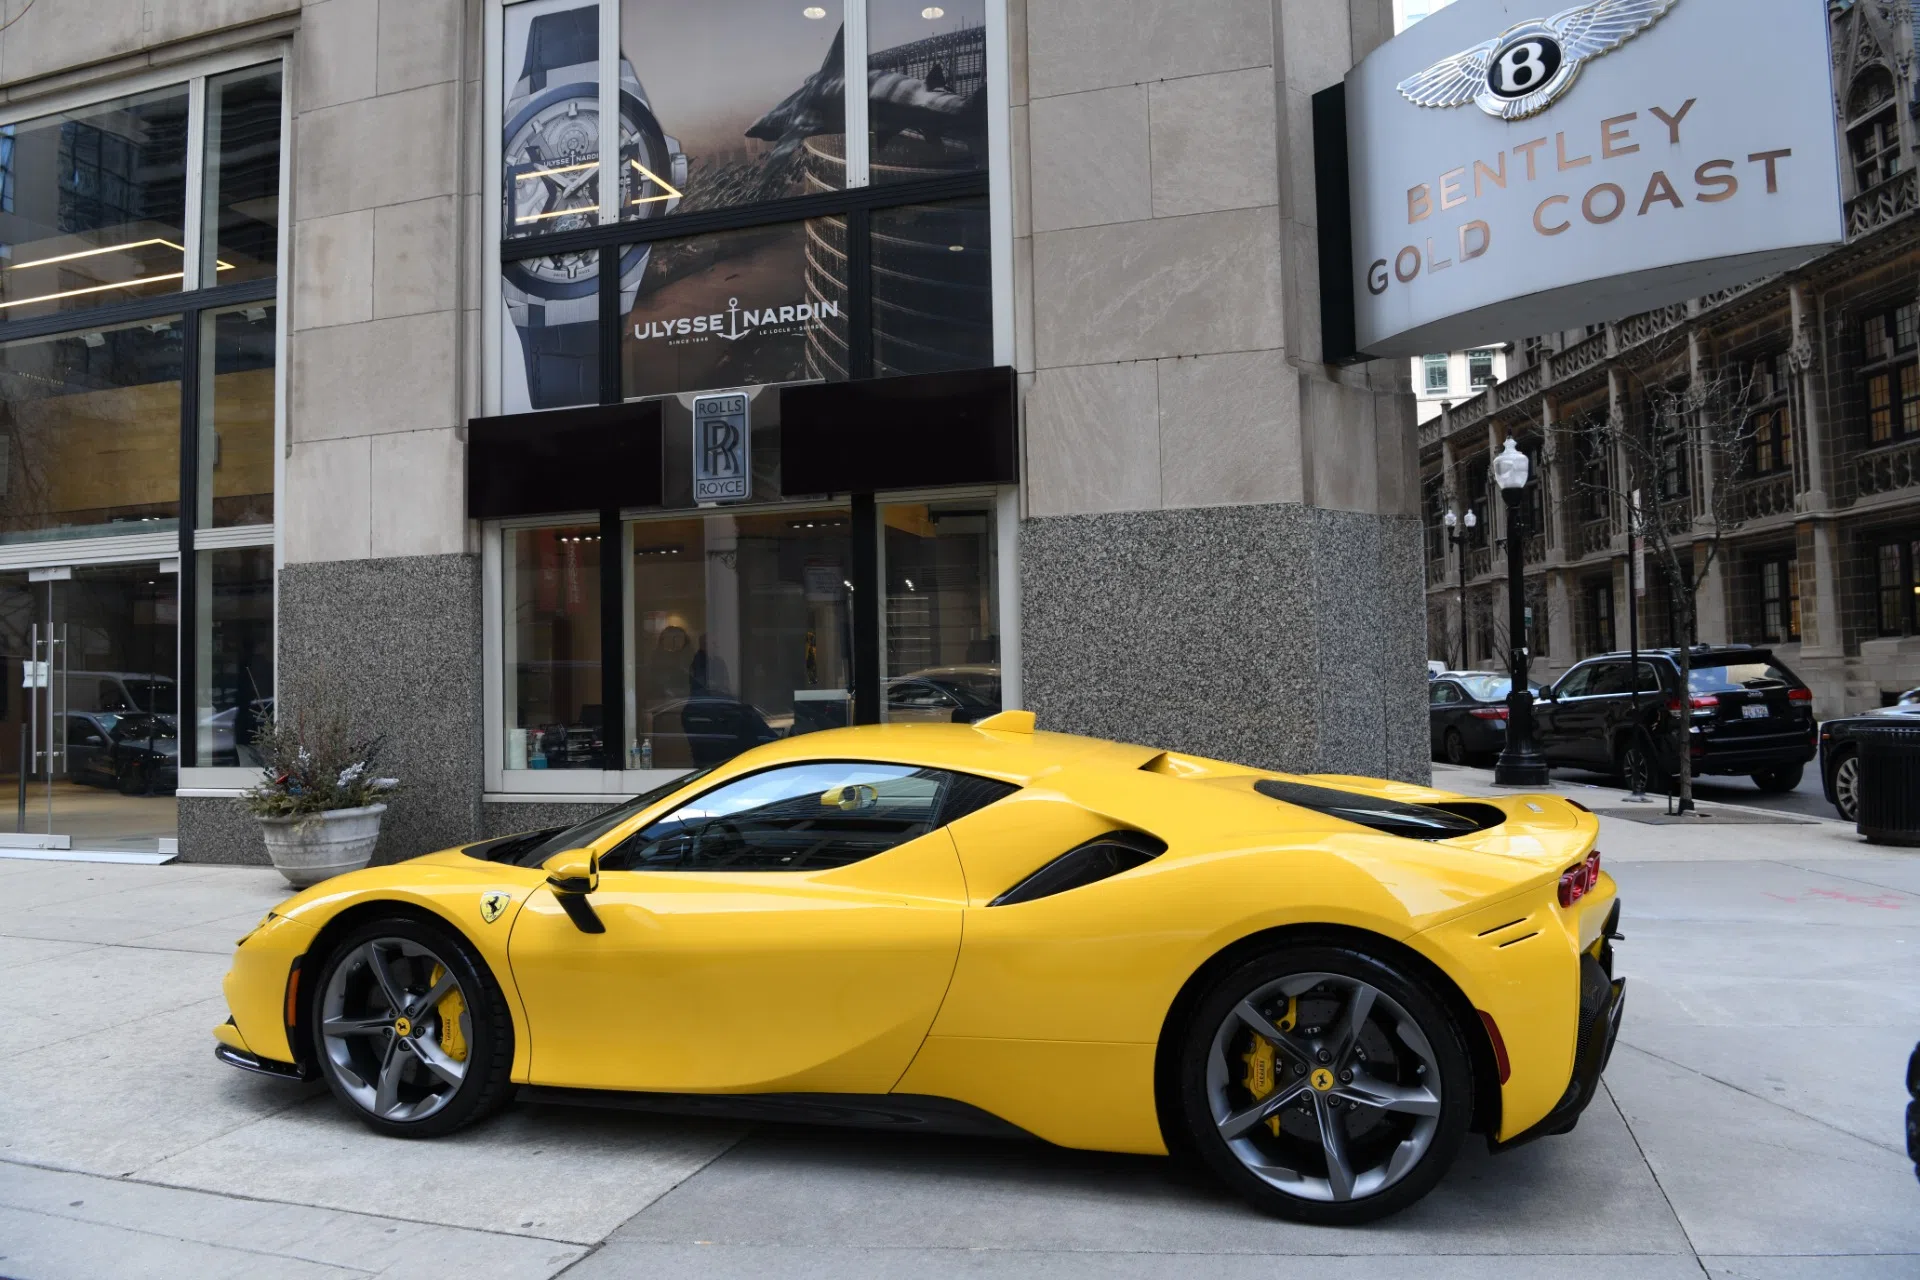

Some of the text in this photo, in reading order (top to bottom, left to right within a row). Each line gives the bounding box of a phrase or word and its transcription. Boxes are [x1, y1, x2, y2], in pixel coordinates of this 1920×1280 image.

[1499, 41, 1546, 93] B
[543, 153, 599, 167] ULYSSE NARDI
[1407, 98, 1697, 224] BENTLEY
[1366, 148, 1792, 296] GOLD COAST
[634, 300, 839, 340] ULYSSE NARDIN
[769, 326, 791, 335] LOCLE
[668, 338, 689, 346] SINCE
[698, 399, 742, 414] ROLLS
[698, 480, 743, 495] ROYCE
